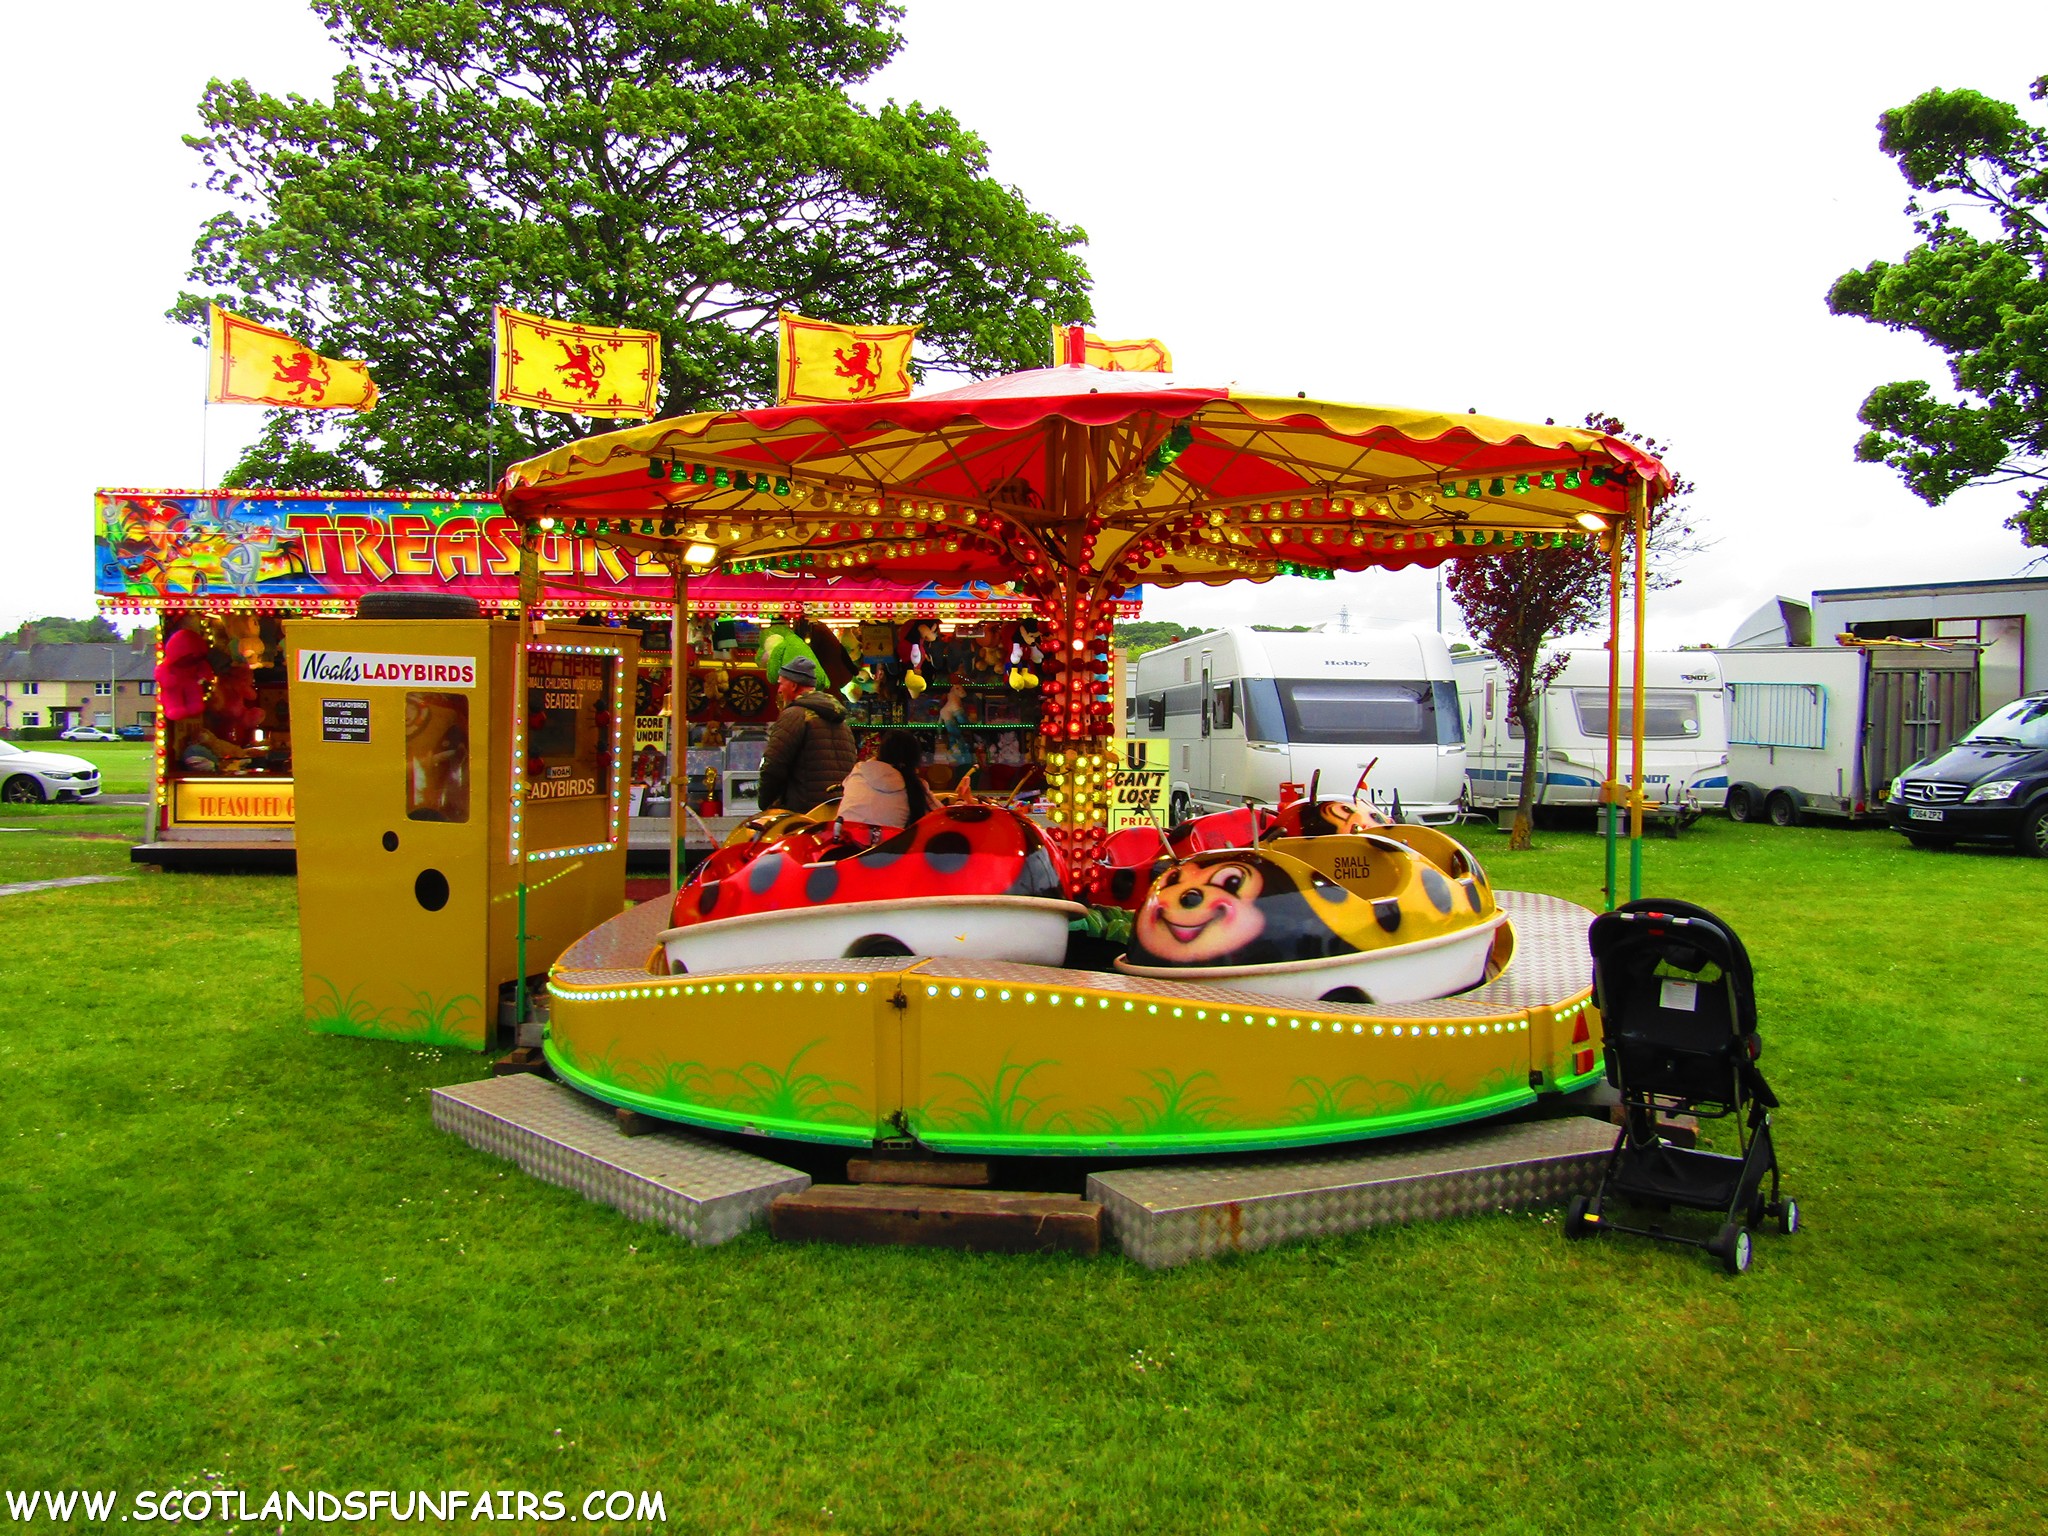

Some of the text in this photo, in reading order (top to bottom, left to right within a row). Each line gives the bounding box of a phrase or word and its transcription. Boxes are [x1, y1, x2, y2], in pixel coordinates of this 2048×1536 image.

[302, 652, 474, 683] Noahs LADYBIRDS
[528, 652, 602, 677] PAY HERE
[1324, 660, 1371, 668] Hobby
[545, 677, 572, 690] CHILDREN
[544, 692, 583, 710] SEATBELT
[324, 716, 368, 726] BEST KIDS RIDE
[636, 717, 663, 728] SCORE
[636, 731, 663, 742] UNDER
[1127, 741, 1147, 771] U
[551, 767, 570, 777] NOAH
[1114, 772, 1165, 787] CAN'T
[1625, 774, 1670, 784] FNDT
[527, 778, 595, 799] ADYBIRDS
[1117, 788, 1162, 804] LOSE
[199, 796, 282, 817] TREASURED
[1334, 856, 1370, 868] SMALL
[1334, 867, 1370, 880] CHILD
